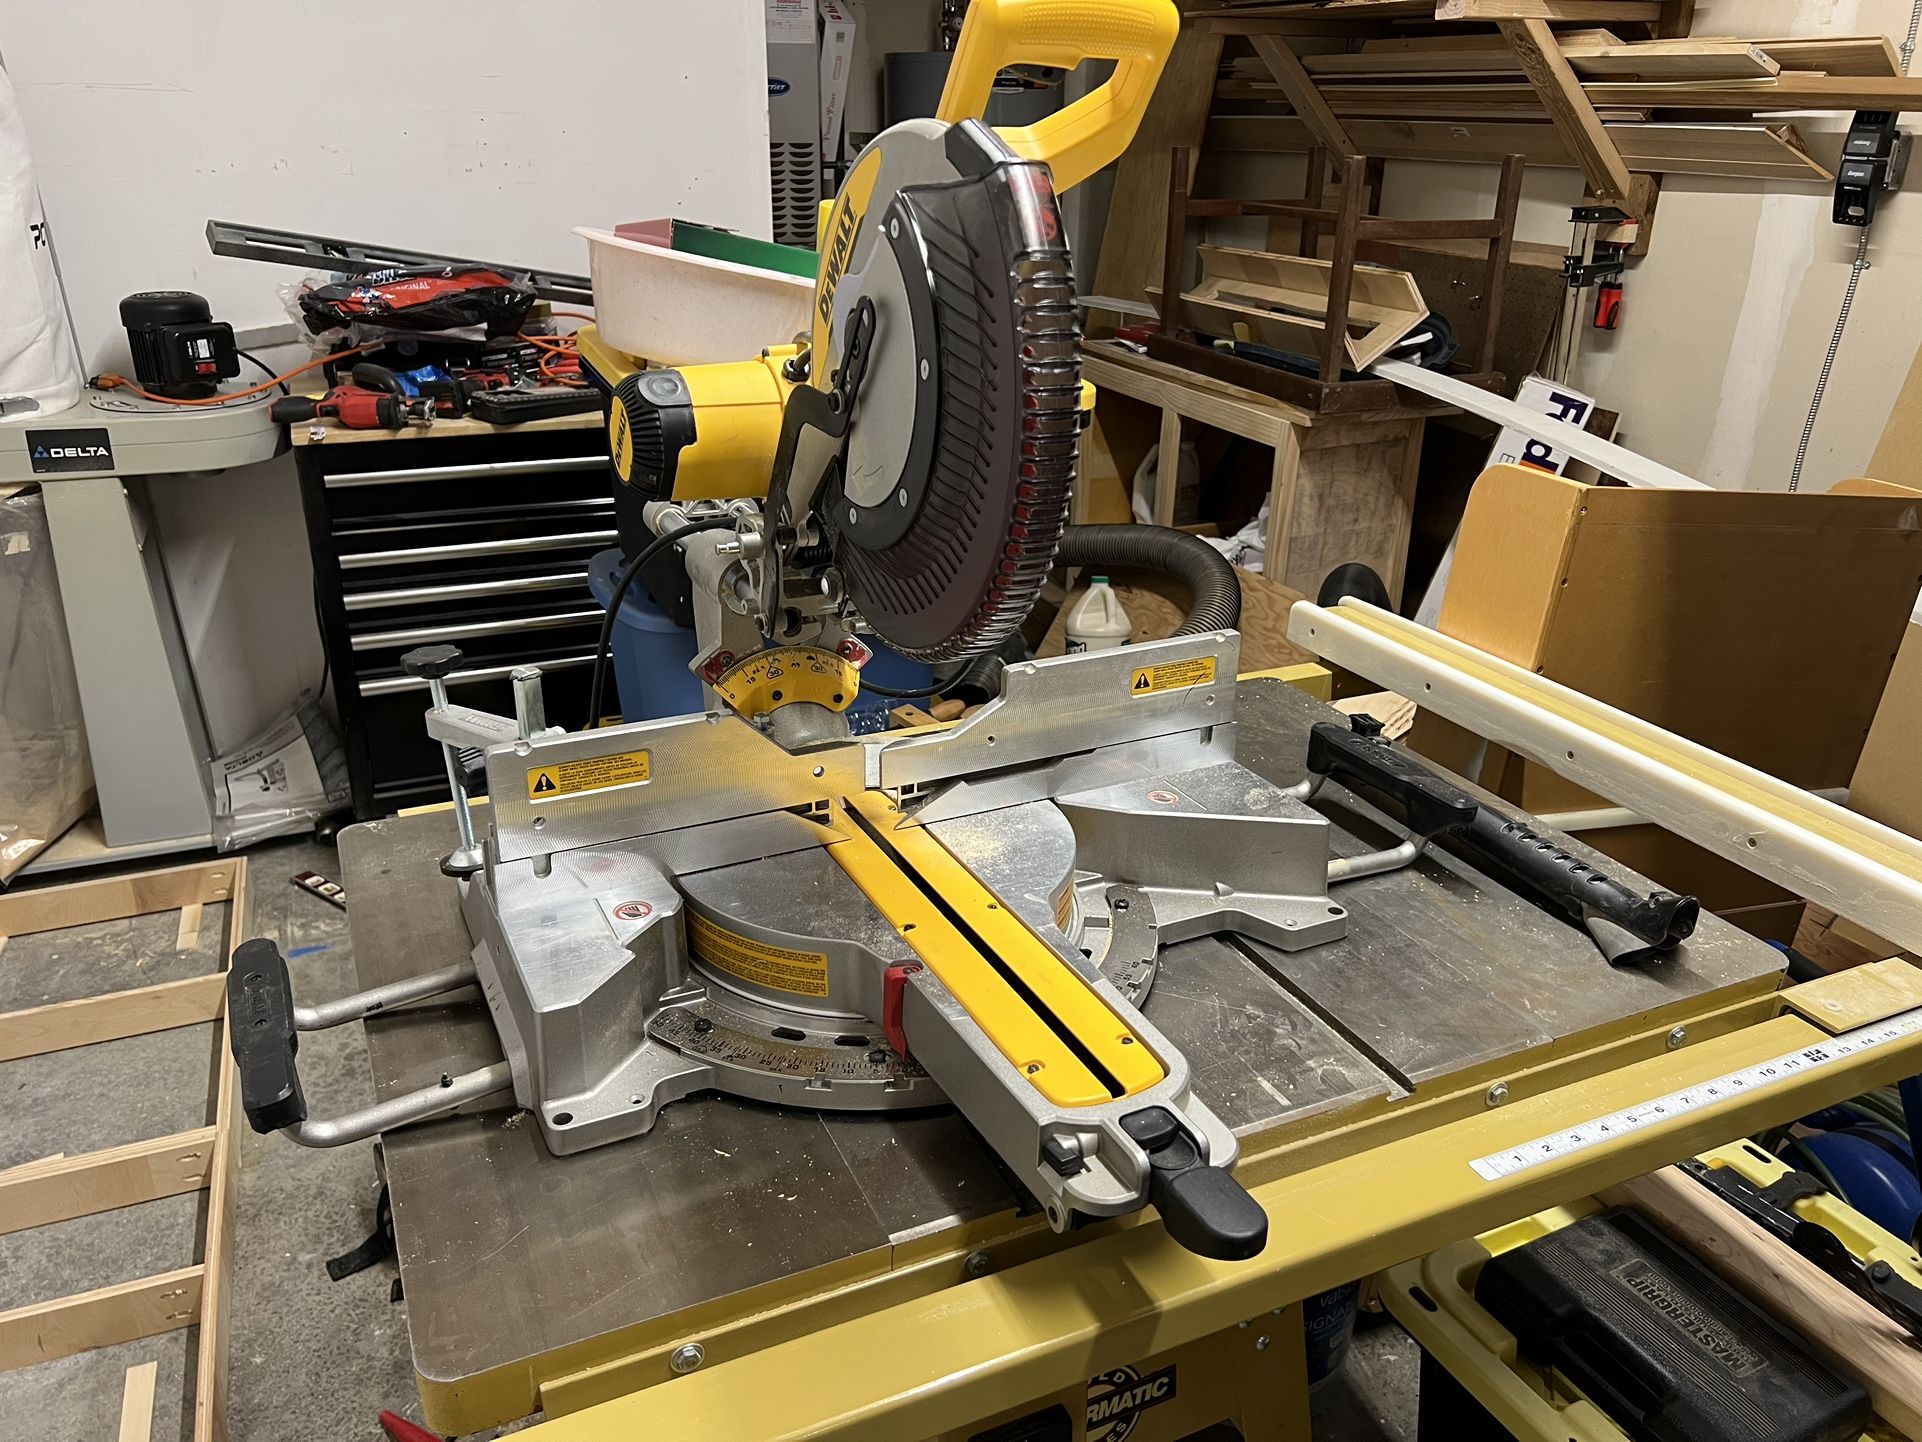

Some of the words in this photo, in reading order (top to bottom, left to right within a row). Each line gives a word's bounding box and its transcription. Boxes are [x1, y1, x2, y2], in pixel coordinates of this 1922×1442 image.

[50, 446, 109, 458] DELTA
[1541, 1144, 1553, 1152] 2
[1570, 1134, 1582, 1142] 3
[1600, 1124, 1610, 1132] 4
[1627, 1114, 1638, 1123] 5
[1758, 1068, 1776, 1077] 10
[1783, 1060, 1800, 1069] 11
[1626, 1276, 1746, 1372] MASTERGRIP
